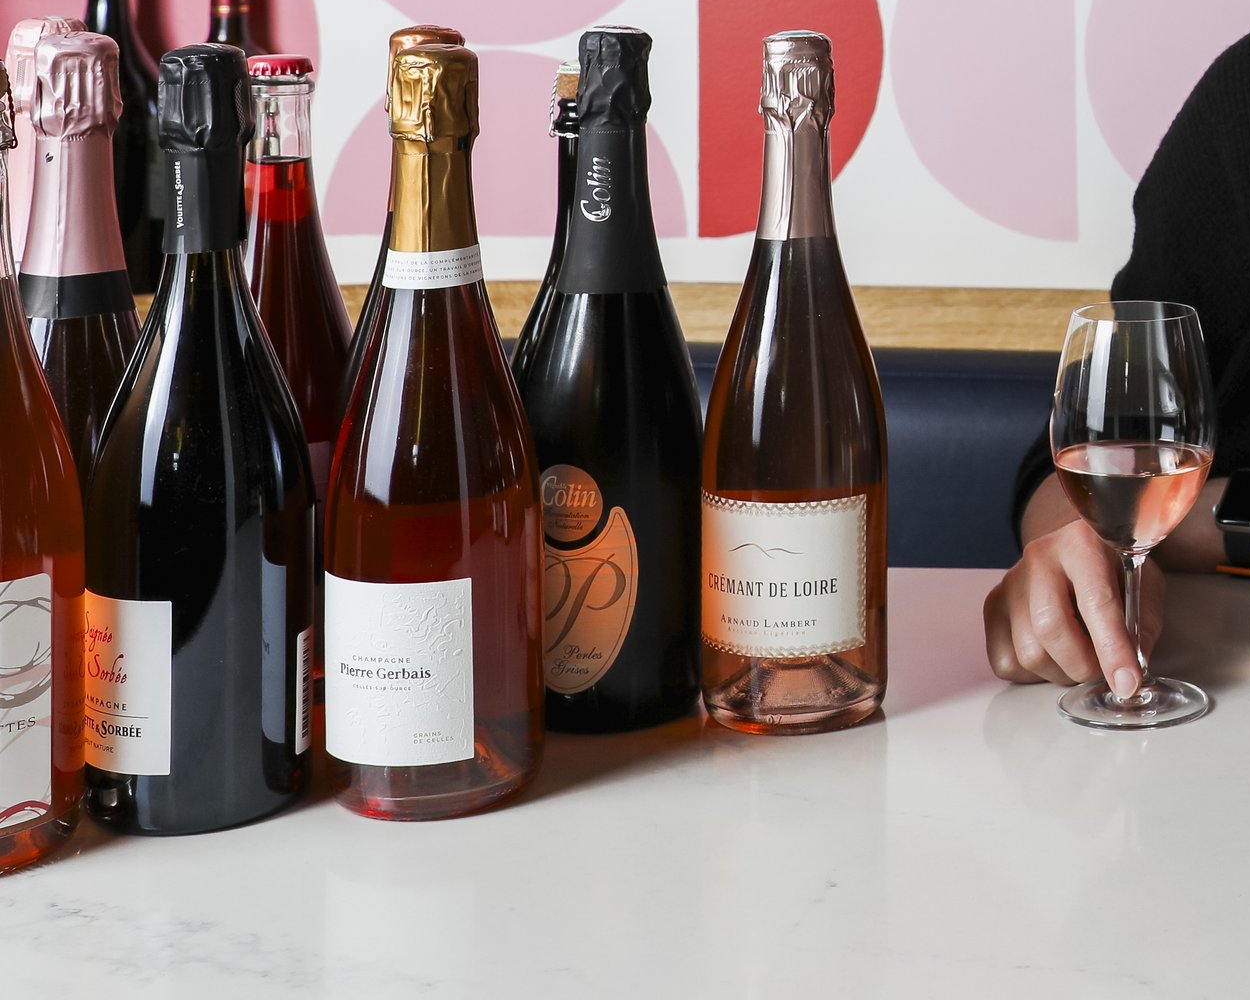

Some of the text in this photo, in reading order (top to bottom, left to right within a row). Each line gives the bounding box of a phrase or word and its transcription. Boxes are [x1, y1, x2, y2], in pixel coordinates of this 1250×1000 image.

[541, 476, 597, 508] Colin
[708, 572, 838, 598] CRÉMANT DE LOIRE
[720, 613, 817, 629] ARNAUD LAMBERT
[352, 655, 411, 664] CHAMPAGNE
[563, 645, 603, 660] Perles
[87, 654, 128, 684] Sorbée
[340, 663, 432, 680] Pierre Gerbais
[551, 660, 590, 677] Grises
[85, 696, 128, 711] AMPAGNE
[0, 716, 37, 733] TES
[101, 720, 142, 738] SORBÉE
[413, 731, 442, 739] GRAINS
[426, 735, 454, 745] CELLES
[93, 742, 114, 753] NATURE
